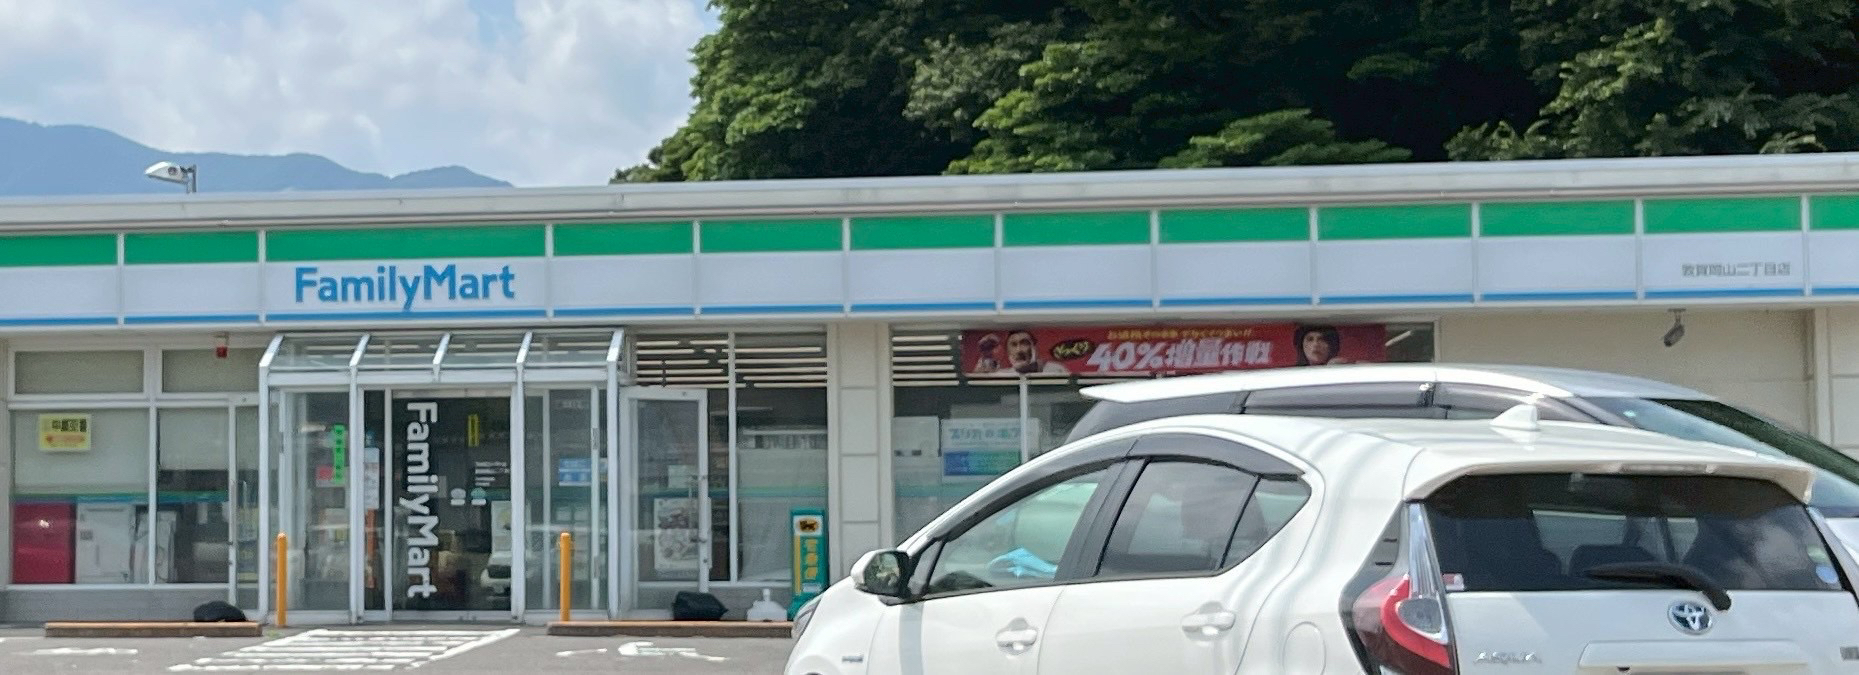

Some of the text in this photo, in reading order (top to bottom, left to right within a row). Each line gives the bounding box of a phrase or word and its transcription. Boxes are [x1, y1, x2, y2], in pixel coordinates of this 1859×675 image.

[295, 264, 516, 312] FamilyMart
[1086, 337, 1272, 373] 40%増量作戦
[400, 402, 439, 598] FamilyMart
